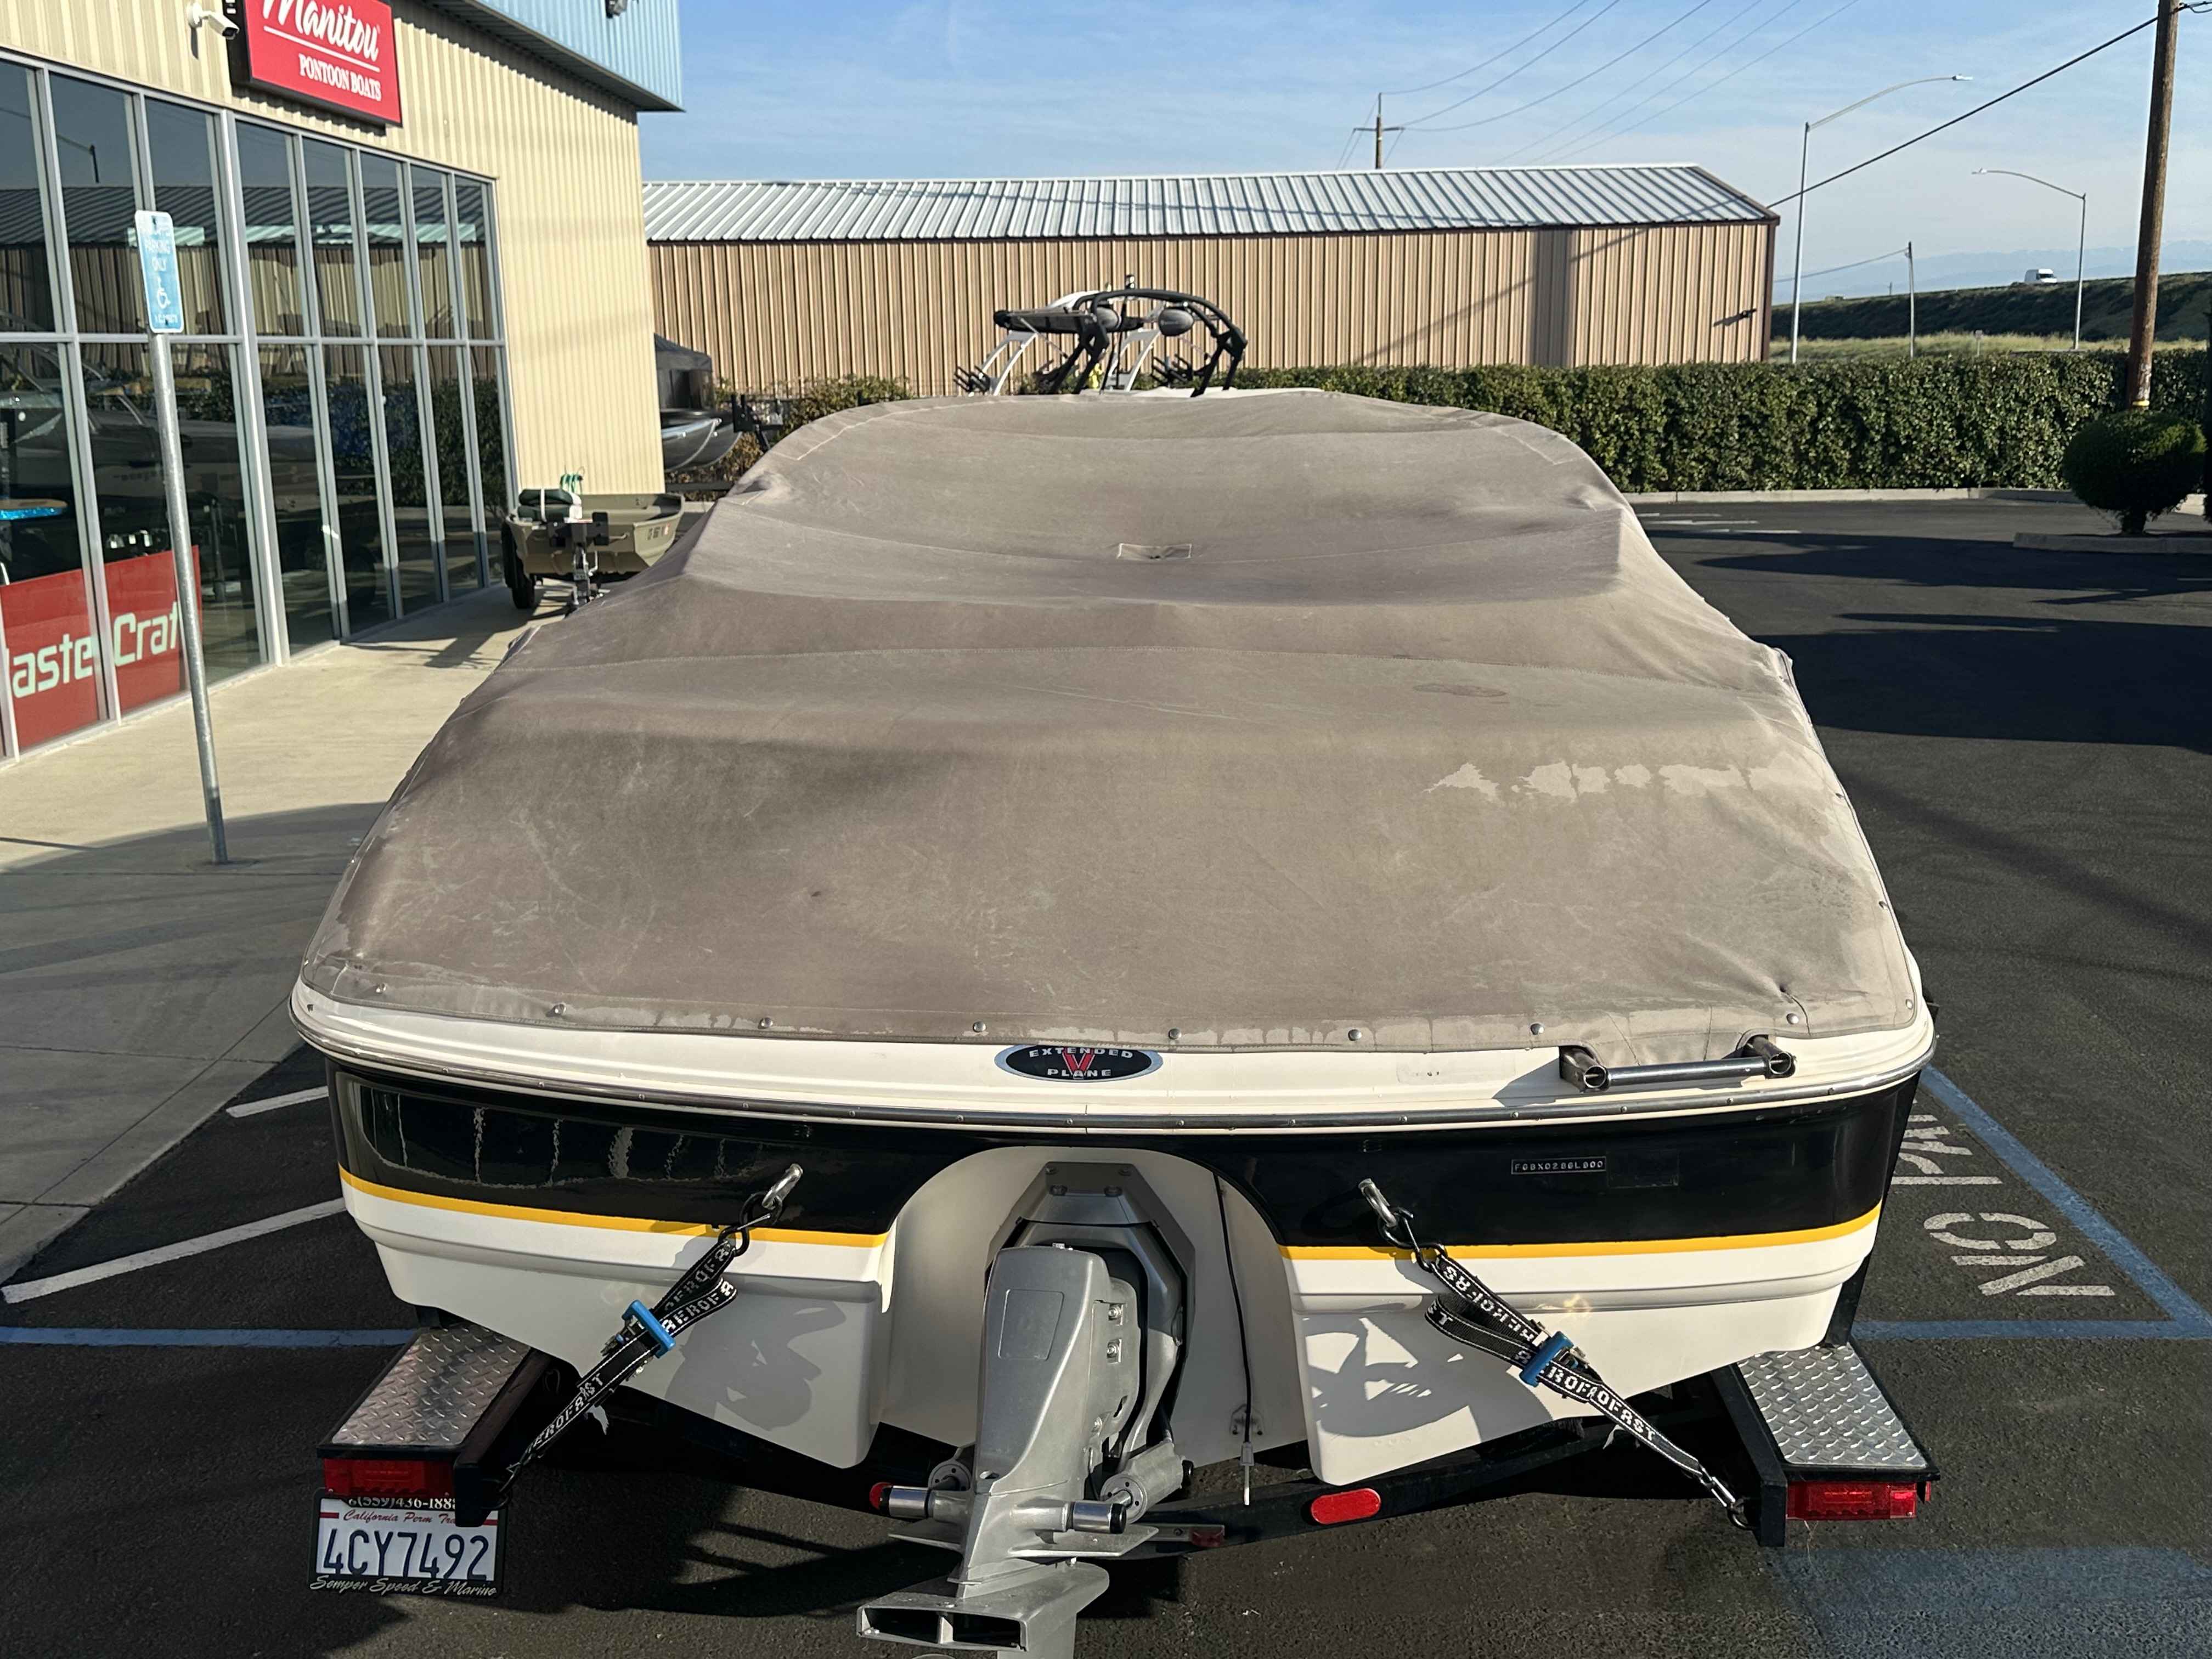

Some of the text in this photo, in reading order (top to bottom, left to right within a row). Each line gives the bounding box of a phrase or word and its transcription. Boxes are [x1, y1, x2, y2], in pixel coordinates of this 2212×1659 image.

[298, 53, 381, 101] PONTOON BOATS
[1029, 1047, 1133, 1059] EXTENDED
[1047, 1068, 1111, 1079] PLANE
[1923, 1212, 2116, 1296] NO
[343, 1509, 398, 1522] California
[403, 1512, 433, 1523] Perm
[323, 1528, 489, 1581] 4CY7492
[309, 1575, 497, 1596] Semper Speed & Marine
